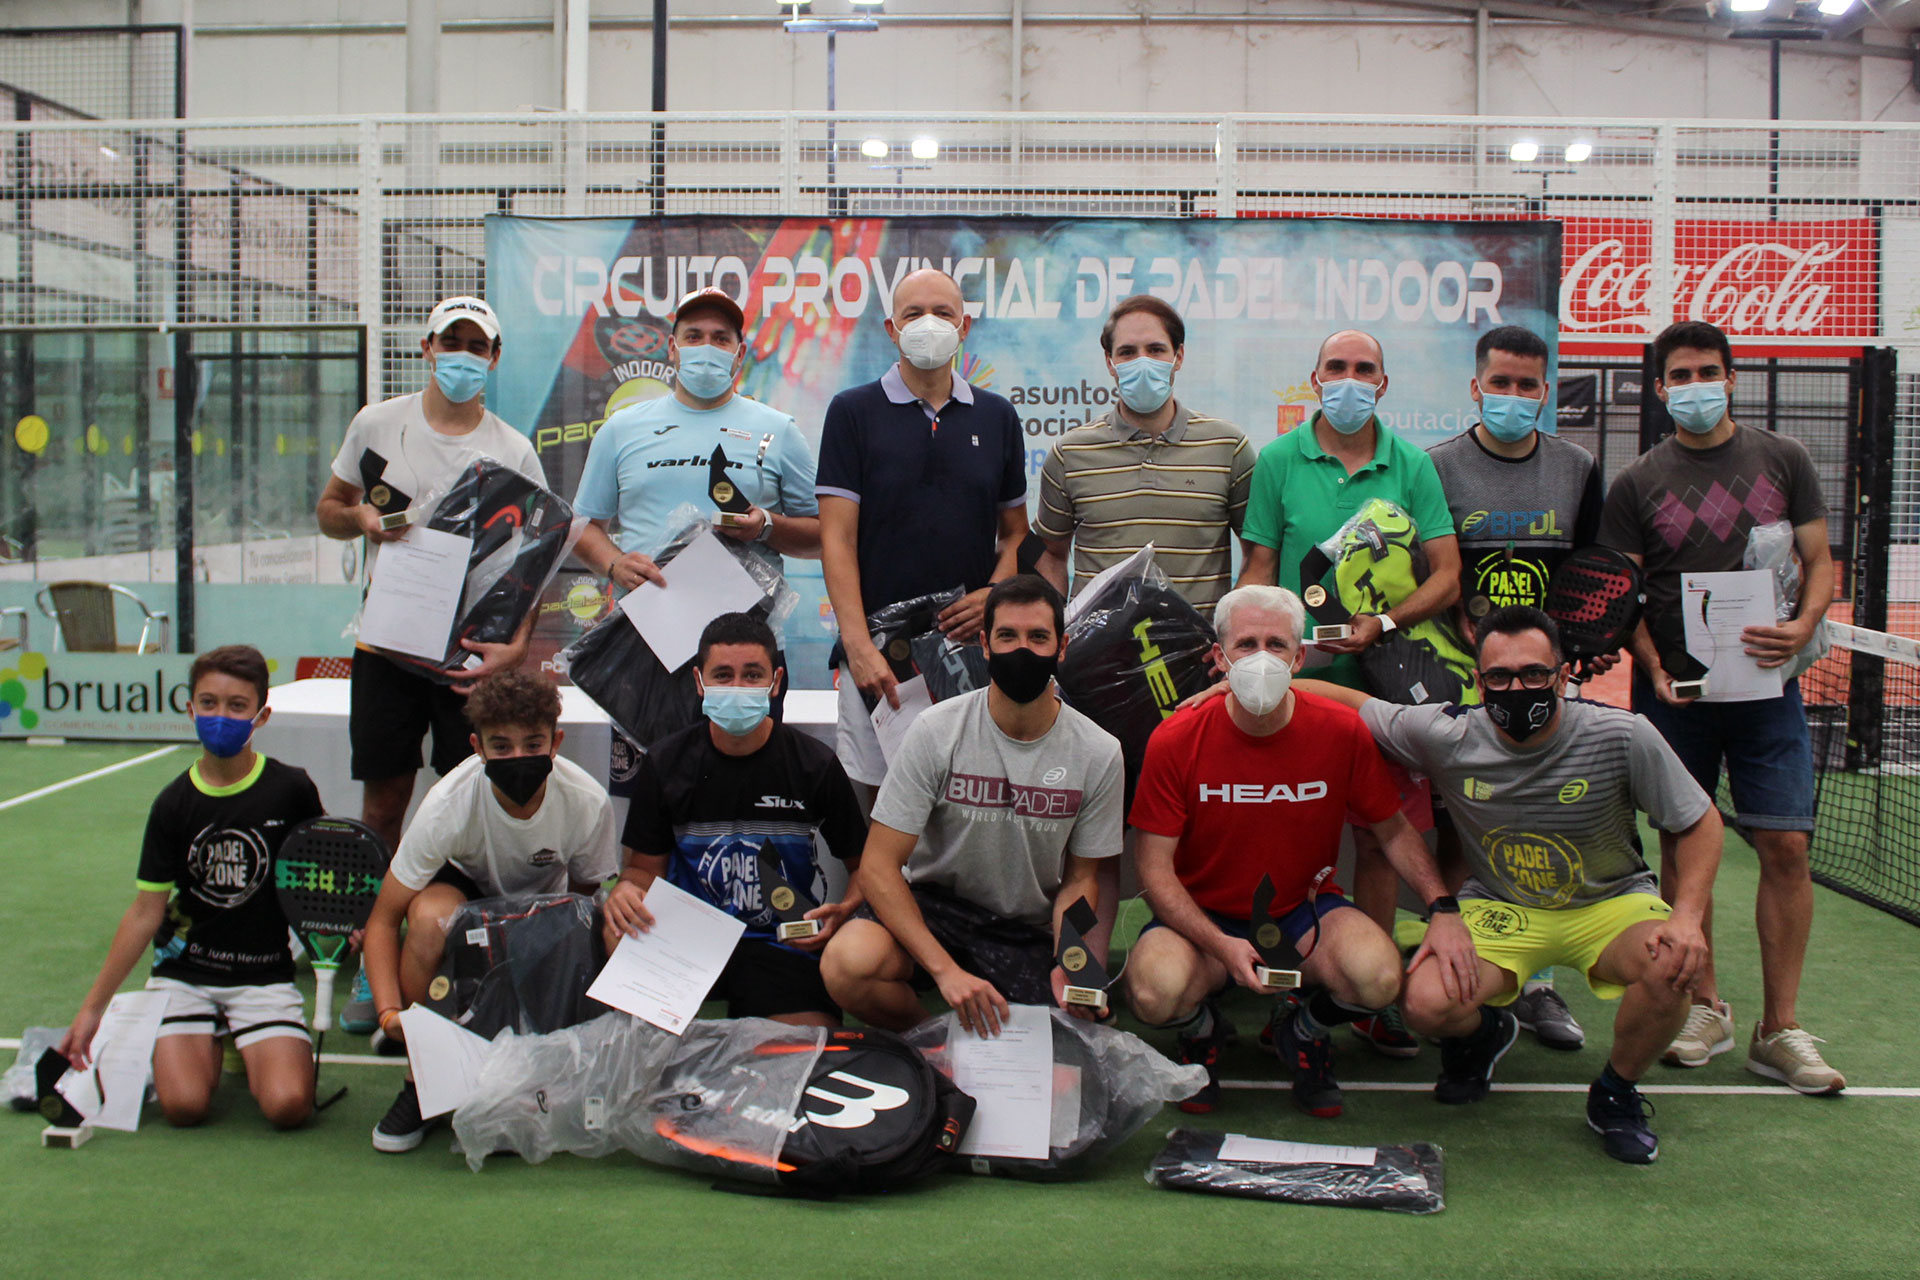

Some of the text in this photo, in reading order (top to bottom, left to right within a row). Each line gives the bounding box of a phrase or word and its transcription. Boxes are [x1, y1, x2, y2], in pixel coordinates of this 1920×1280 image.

[533, 255, 1503, 324] CIRCUITO PROVCIAL DE PADEL INDOOR
[613, 360, 675, 383] INDOOR
[646, 455, 743, 469] varlin
[1199, 780, 1328, 803] HEAD
[1030, 821, 1059, 832] TOUR
[205, 840, 248, 865] PADEL
[1502, 843, 1556, 870] PADEL
[204, 863, 248, 888] ZONE
[1507, 865, 1560, 893] ZONE
